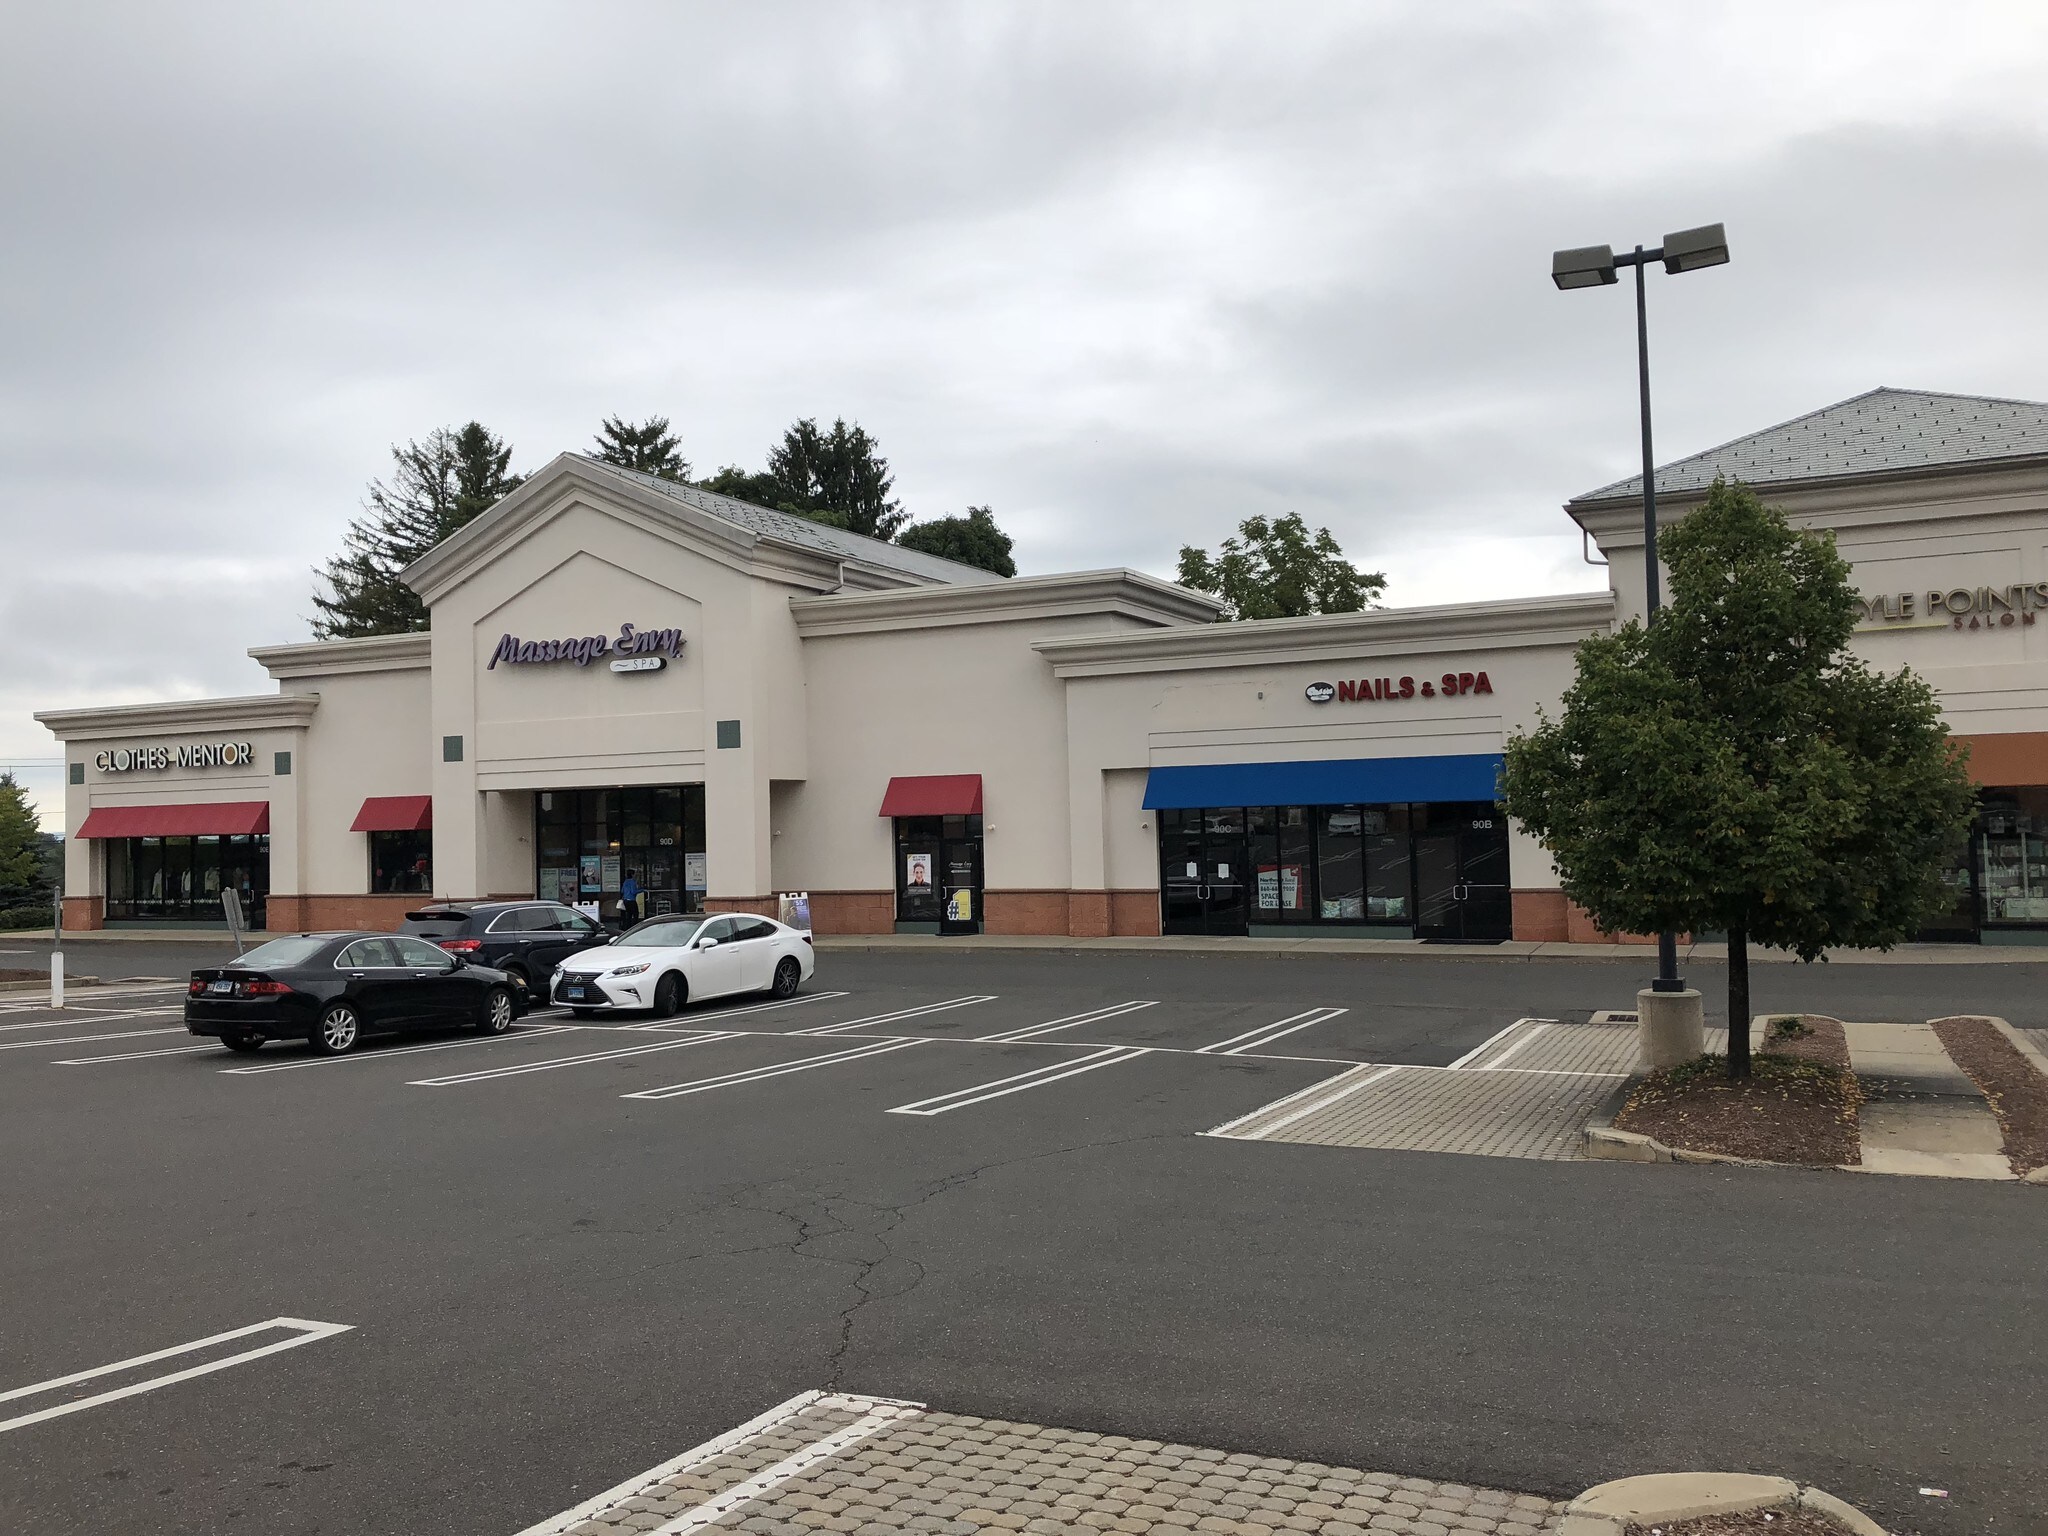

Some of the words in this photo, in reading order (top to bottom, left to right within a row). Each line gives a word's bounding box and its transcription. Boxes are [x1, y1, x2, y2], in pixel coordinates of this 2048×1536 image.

[1850, 593, 1915, 621] YLE
[1926, 581, 2048, 617] POINTS
[1953, 611, 2036, 632] SALON
[487, 633, 608, 670] Massage
[612, 623, 683, 658] Envy
[1338, 676, 1415, 702] NAILS
[1421, 681, 1435, 697] &
[1441, 671, 1493, 696] SPA
[95, 747, 168, 772] CLOTHES
[176, 742, 252, 768] MENTOR
[1214, 825, 1232, 833] 90C
[1472, 820, 1492, 829] 90B
[947, 889, 971, 920] #1
[1261, 892, 1280, 900] SPACE
